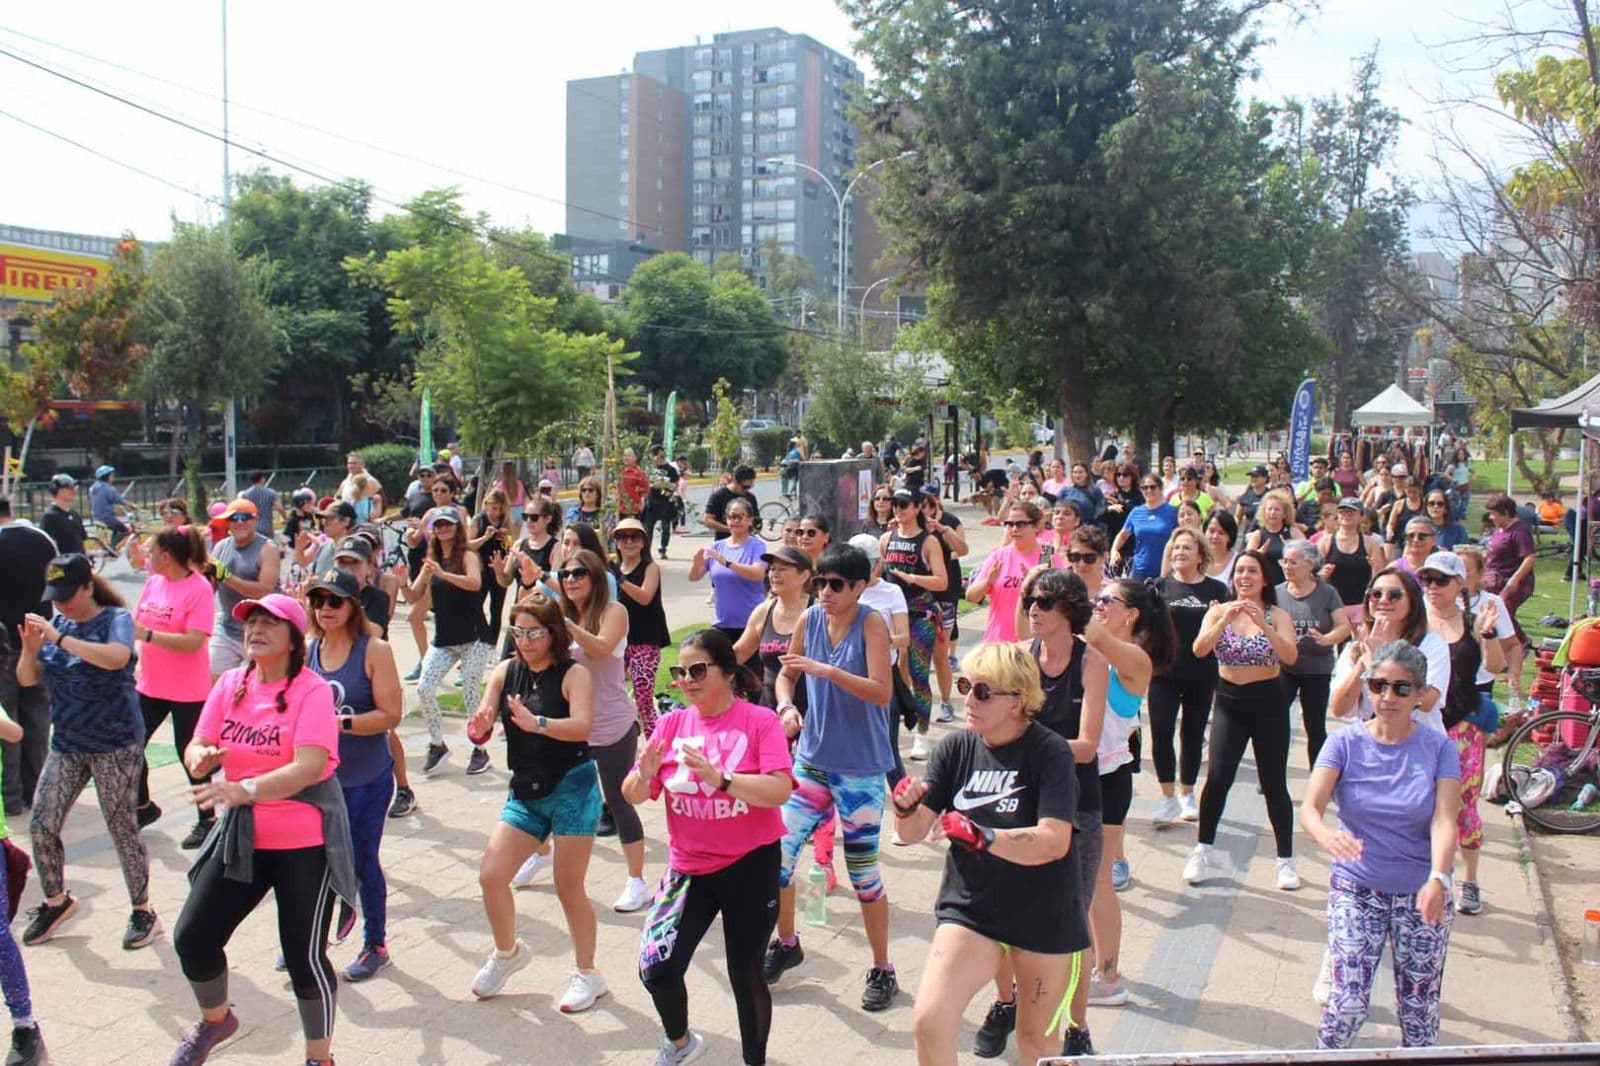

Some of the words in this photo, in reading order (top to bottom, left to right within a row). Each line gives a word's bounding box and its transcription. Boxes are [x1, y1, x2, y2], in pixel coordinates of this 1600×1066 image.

[220, 719, 281, 747] ZUMBA
[965, 770, 1019, 793] NIKE
[671, 796, 749, 820] ZUMBA
[995, 798, 1020, 813] SB
